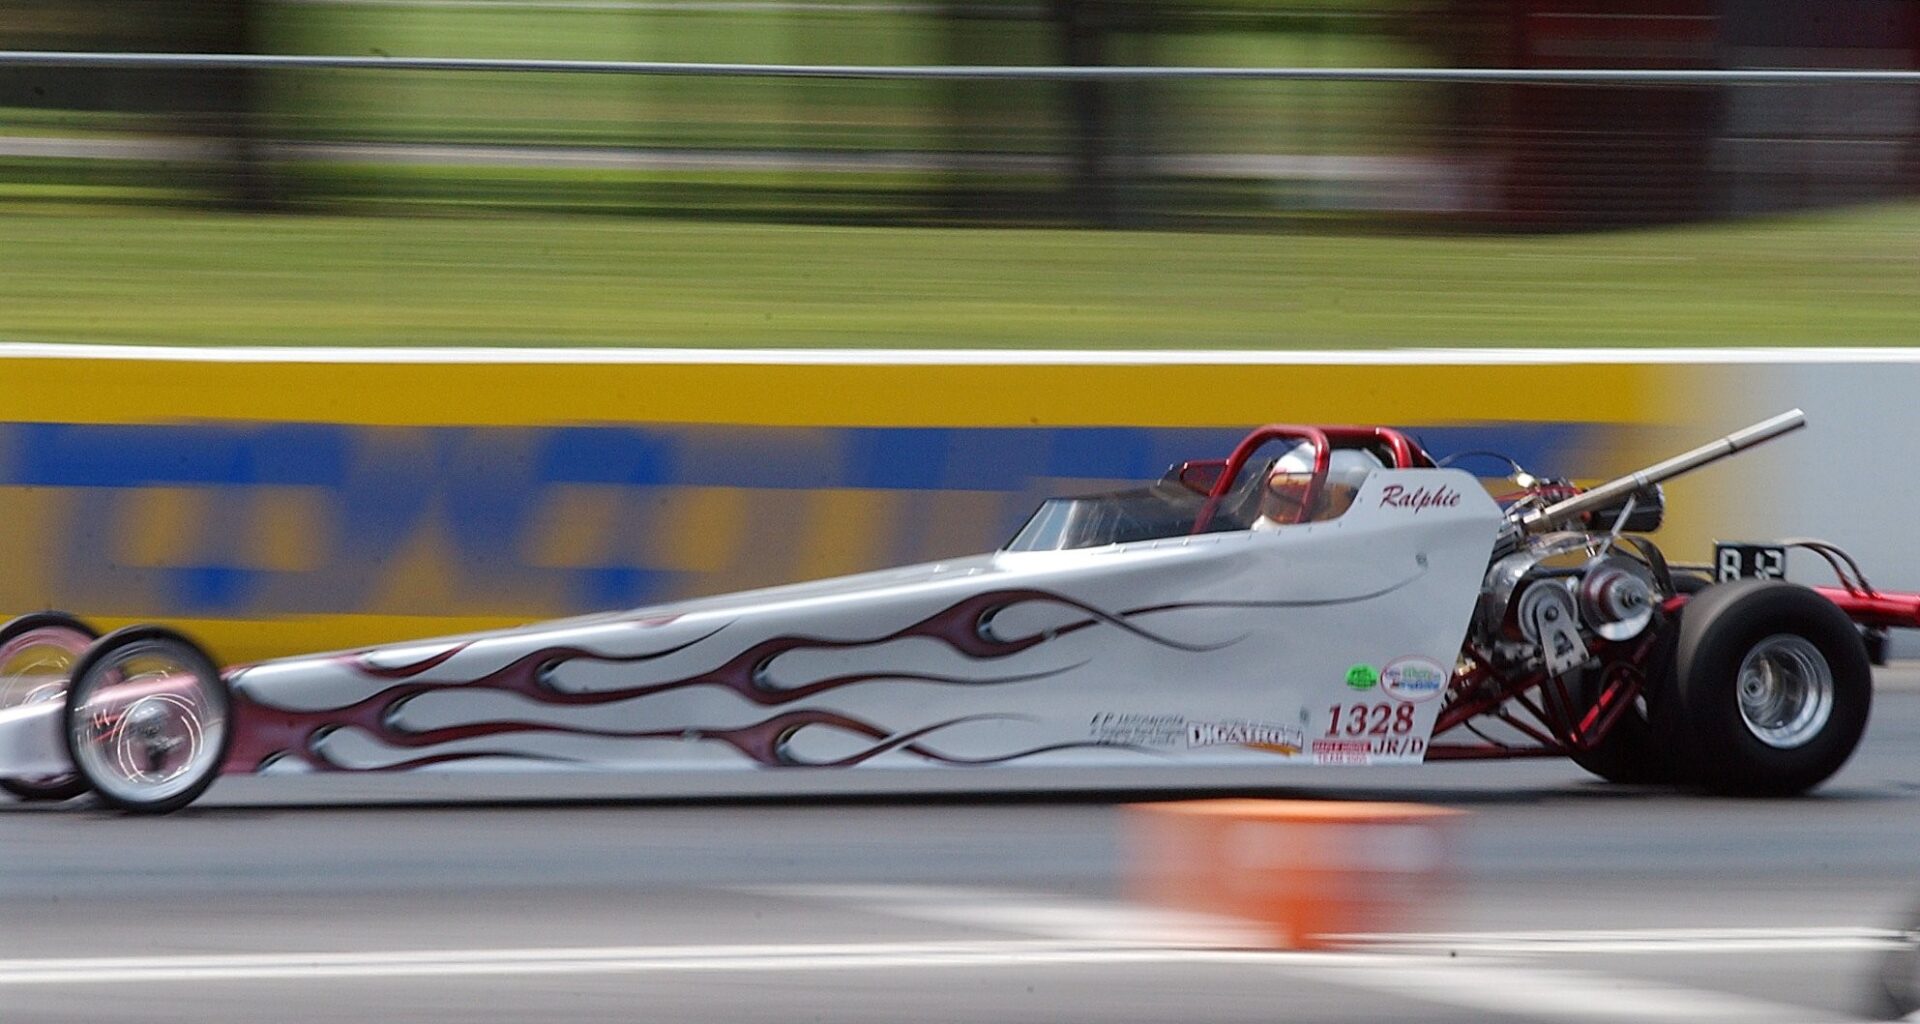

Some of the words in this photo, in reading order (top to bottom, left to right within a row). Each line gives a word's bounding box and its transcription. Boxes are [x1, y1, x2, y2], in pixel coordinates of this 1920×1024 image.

[1379, 484, 1461, 514] Ralphie
[1325, 701, 1415, 737] 1328
[1373, 736, 1424, 757] JR/D
